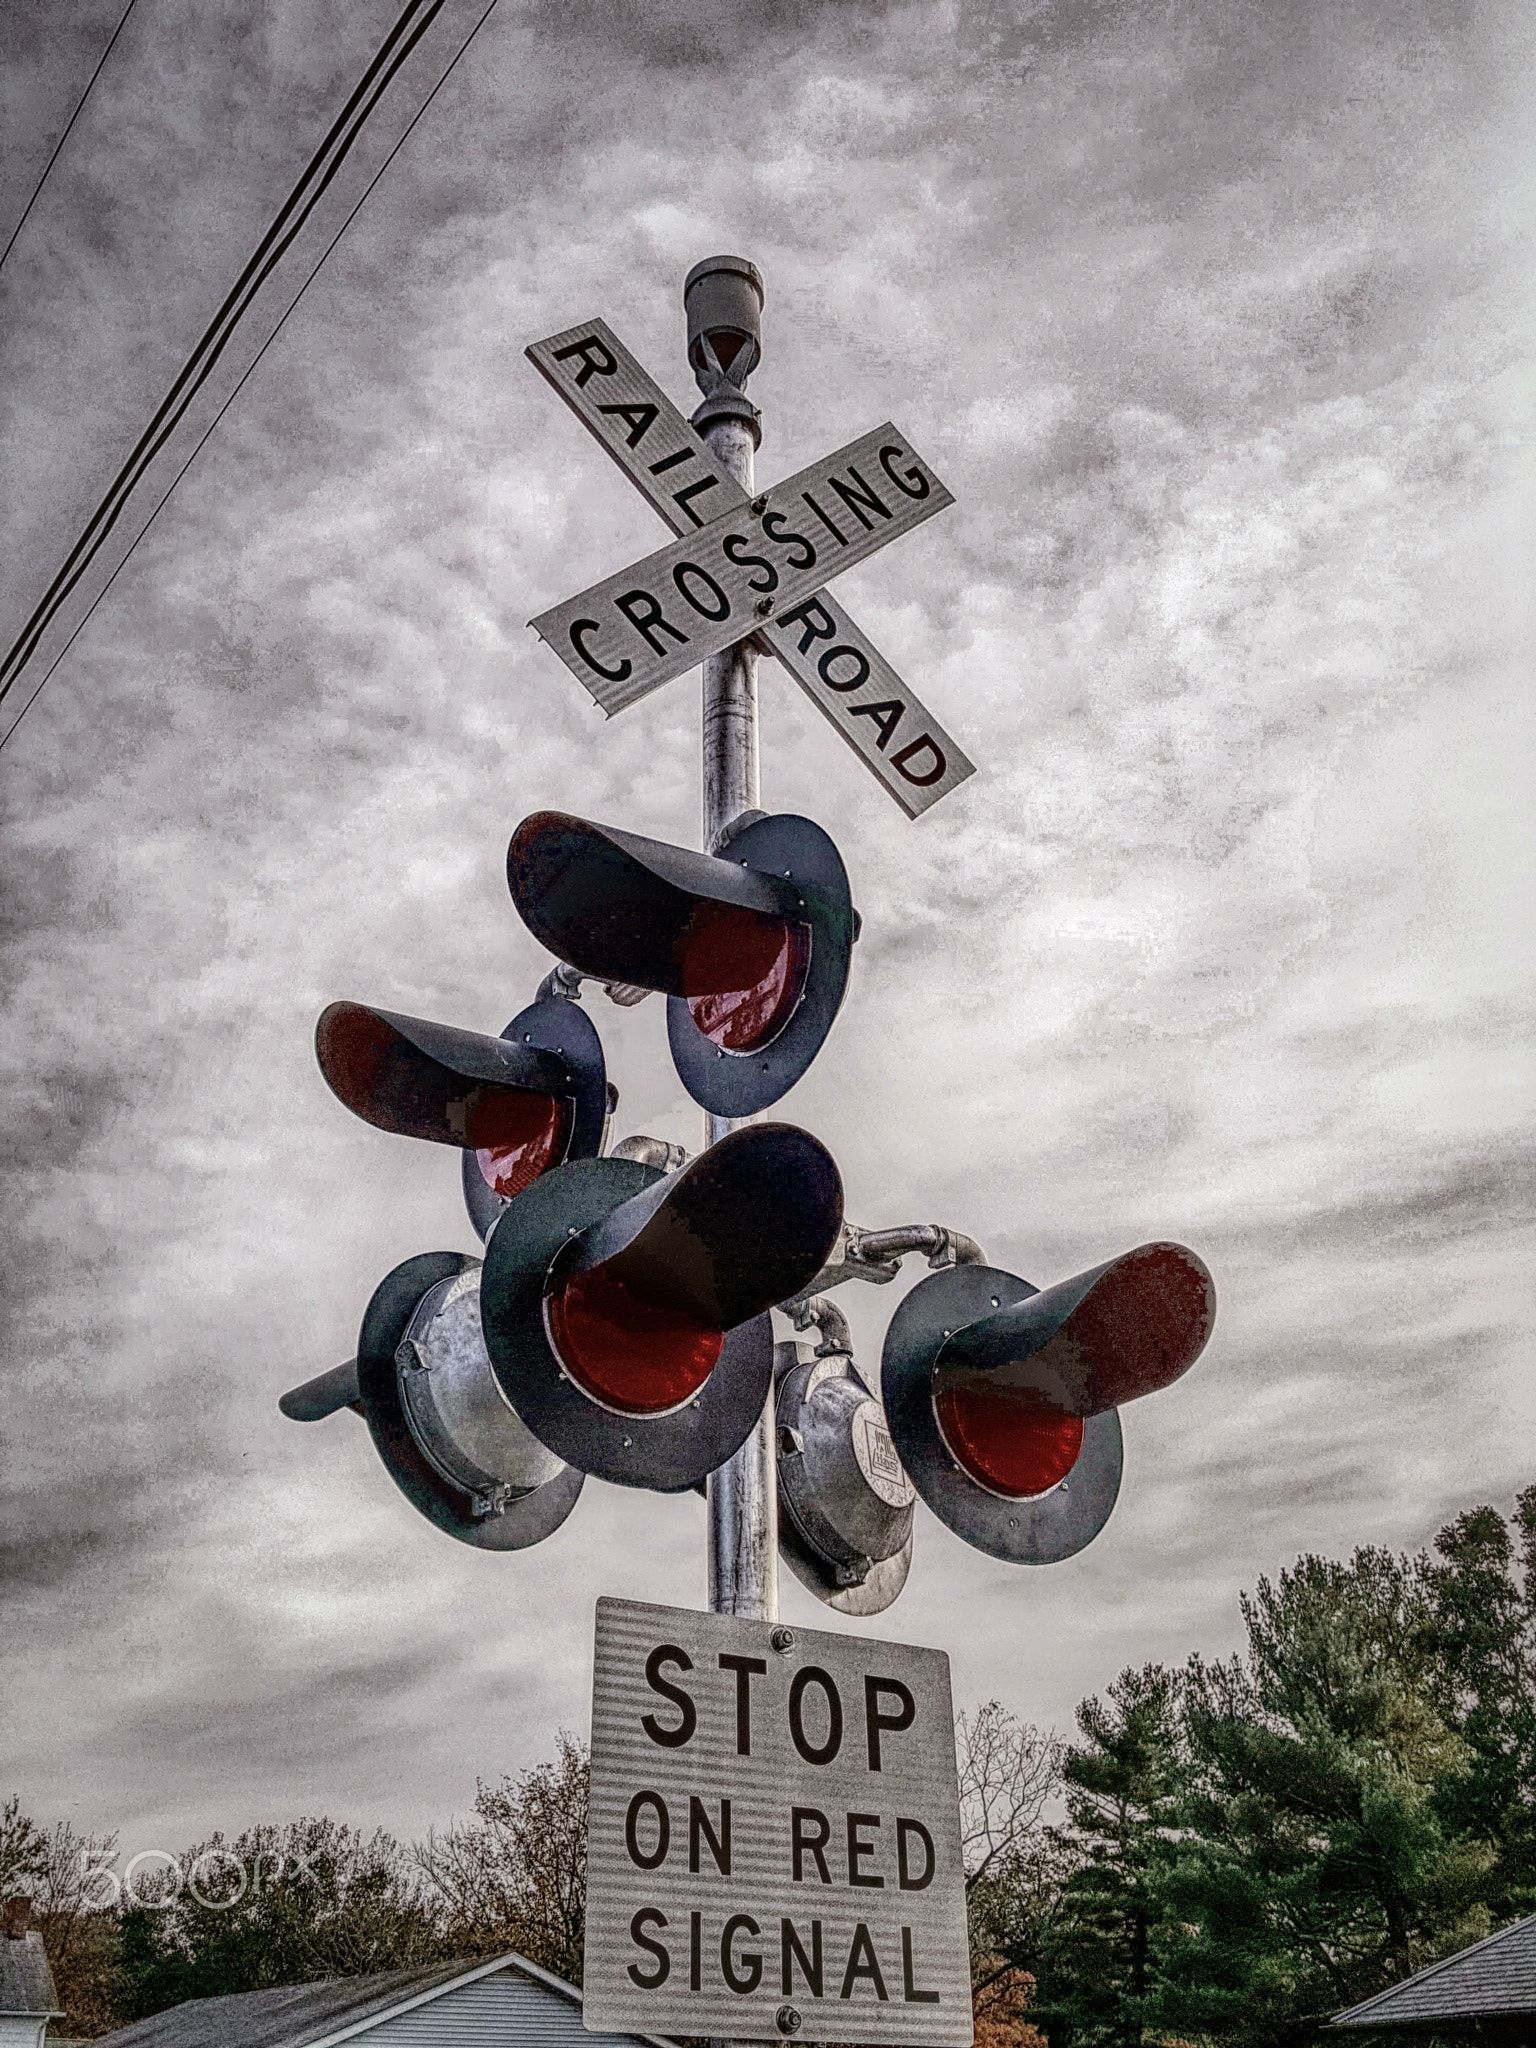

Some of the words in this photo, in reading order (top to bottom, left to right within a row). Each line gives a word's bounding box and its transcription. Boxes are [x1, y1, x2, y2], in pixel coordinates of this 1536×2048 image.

[551, 334, 720, 530] RAIL
[569, 445, 931, 682] CROSSING
[775, 597, 947, 787] ROAD
[640, 1644, 916, 1773] STOP
[625, 1789, 732, 1876] ON
[791, 1806, 936, 1891] RED
[626, 1907, 940, 2004] SIGNAL
